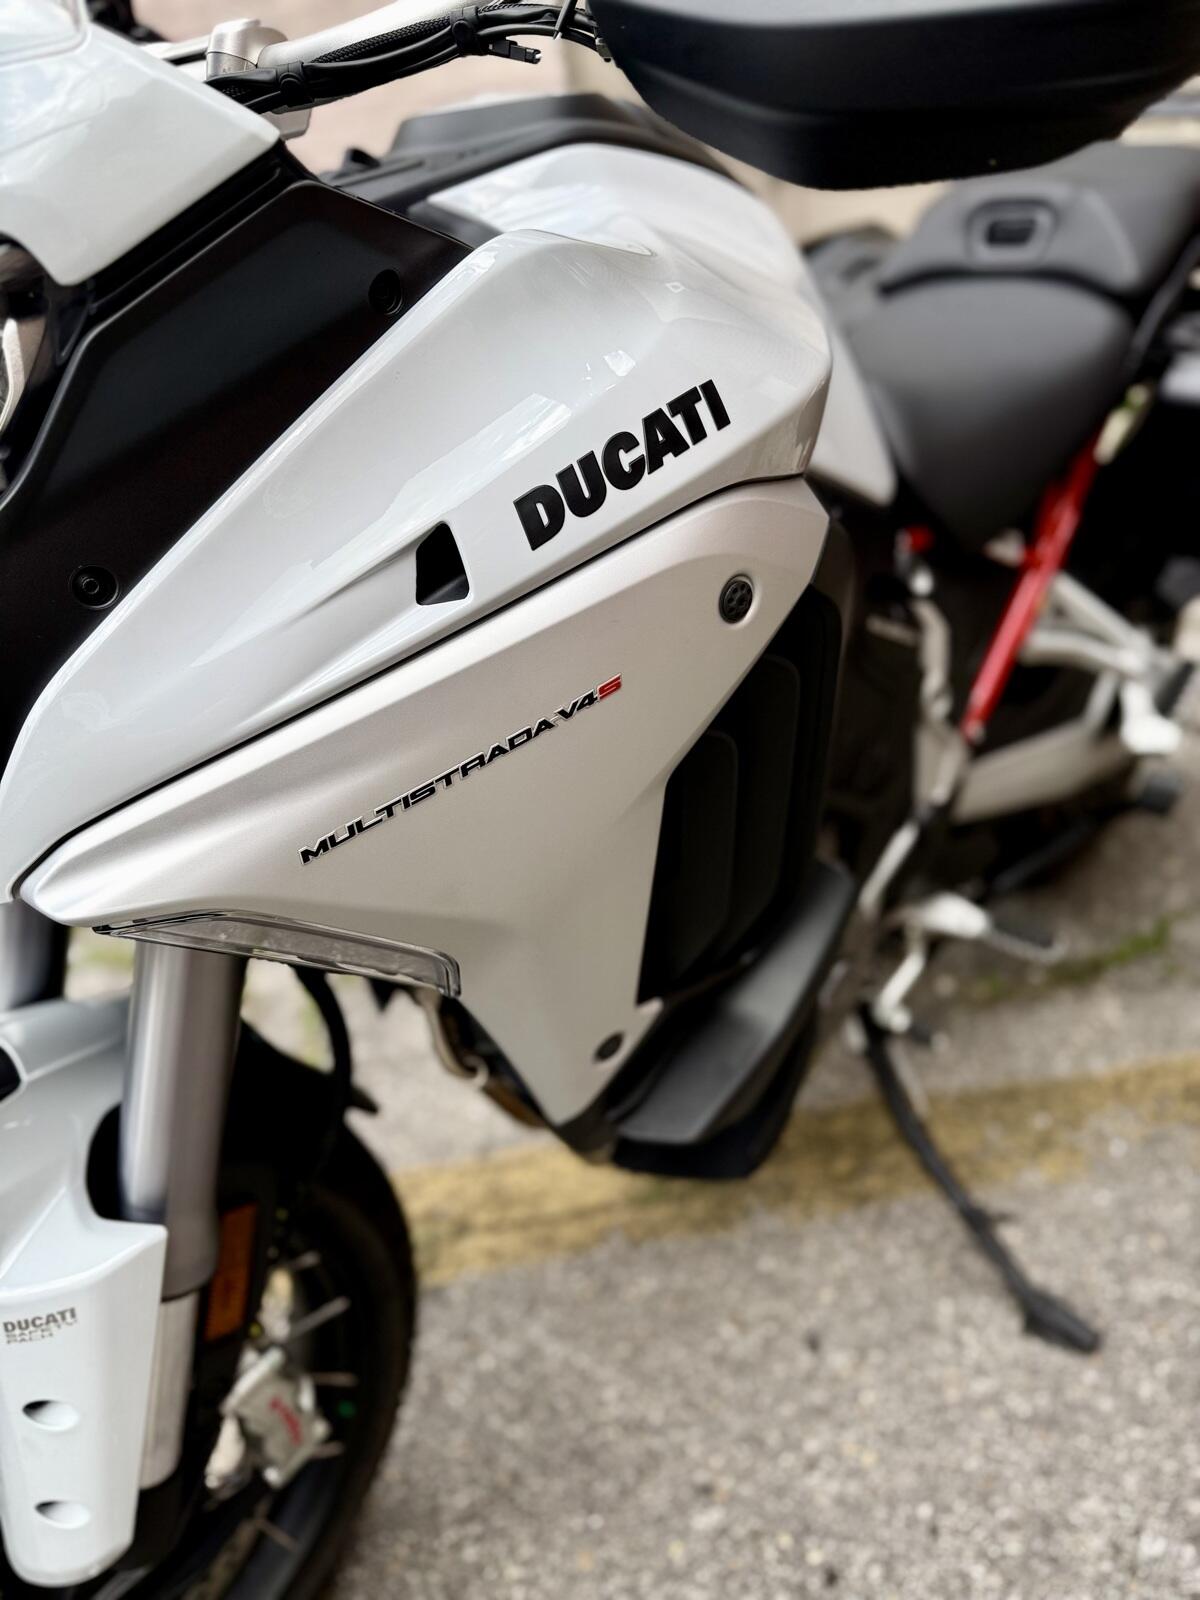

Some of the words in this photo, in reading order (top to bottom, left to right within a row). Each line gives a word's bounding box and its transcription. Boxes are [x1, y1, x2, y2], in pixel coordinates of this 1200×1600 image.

[513, 379, 731, 551] DUCATI
[298, 717, 556, 866] MULTISTRADA
[3, 1307, 77, 1333] DUCATI
